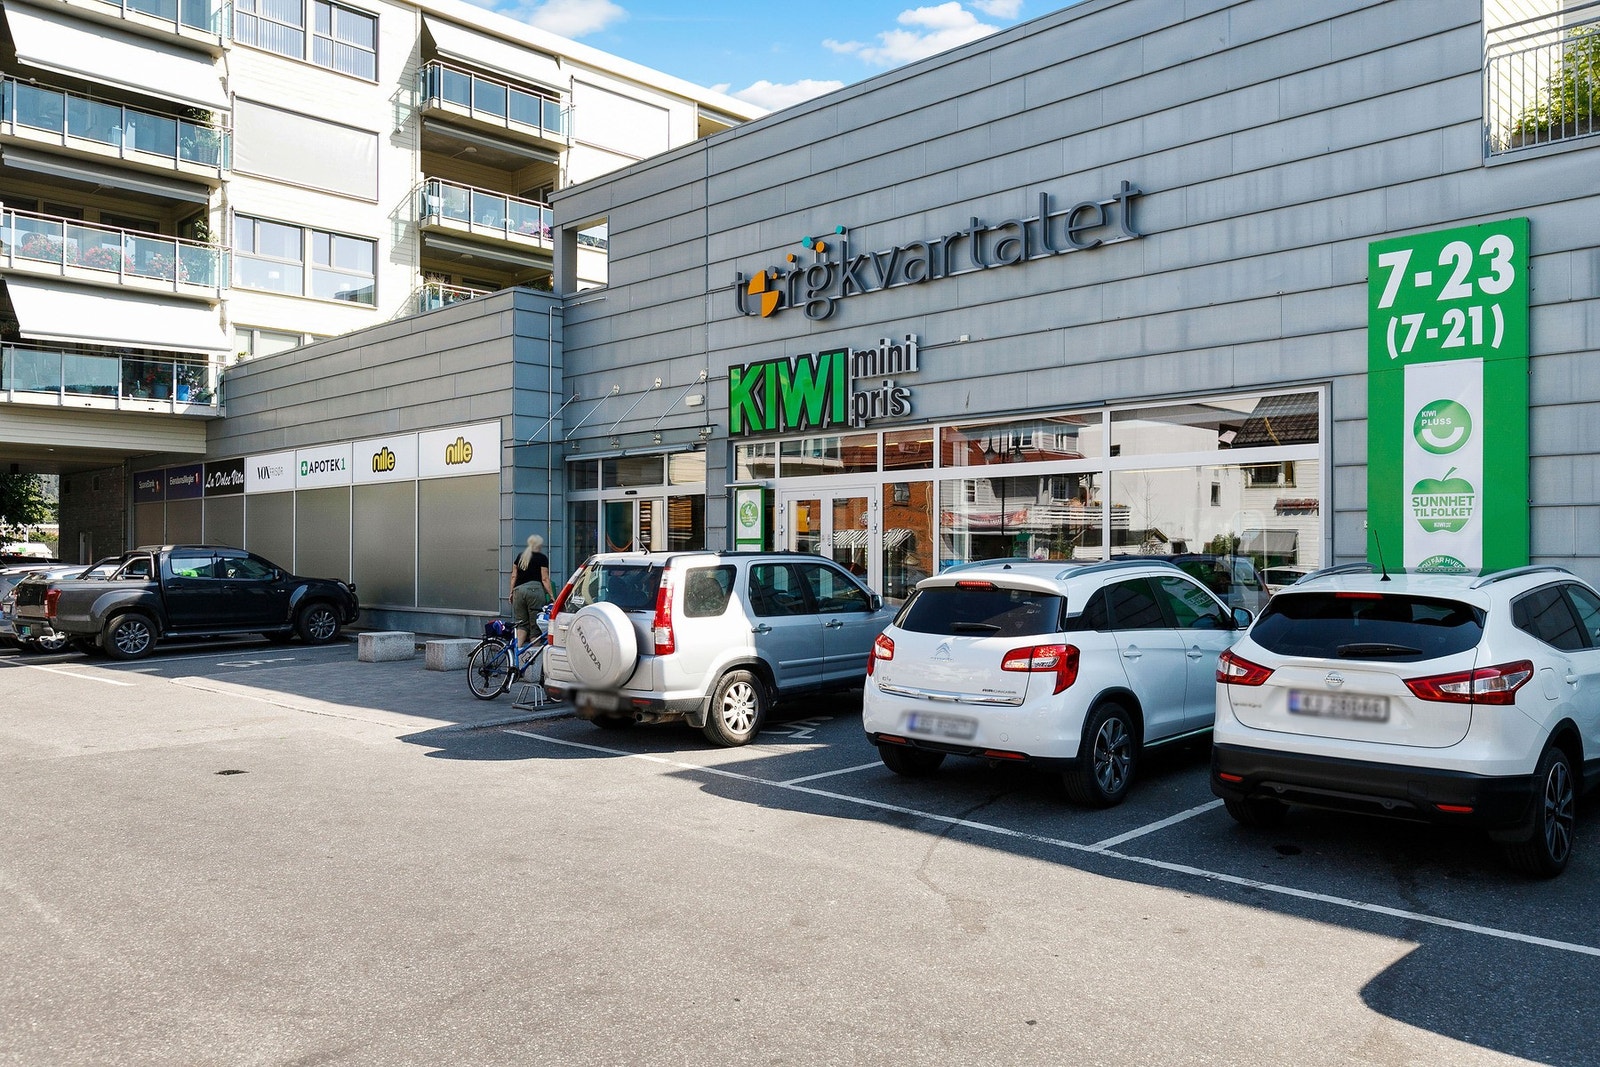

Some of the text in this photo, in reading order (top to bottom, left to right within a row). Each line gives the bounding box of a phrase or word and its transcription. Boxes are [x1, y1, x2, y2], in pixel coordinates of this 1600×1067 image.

[853, 333, 918, 379] mini
[728, 347, 850, 437] KIWI
[853, 379, 911, 428] pris
[1421, 410, 1437, 418] KIWI
[1421, 417, 1452, 427] PLUSS
[372, 446, 396, 473] nille
[445, 436, 473, 465] nille
[308, 458, 341, 474] APOTEK
[205, 469, 244, 488] La Dolce Vita
[1412, 495, 1475, 507] SUNNHET
[1413, 507, 1473, 517] TIL FOLKET
[576, 625, 601, 672] HONDA
